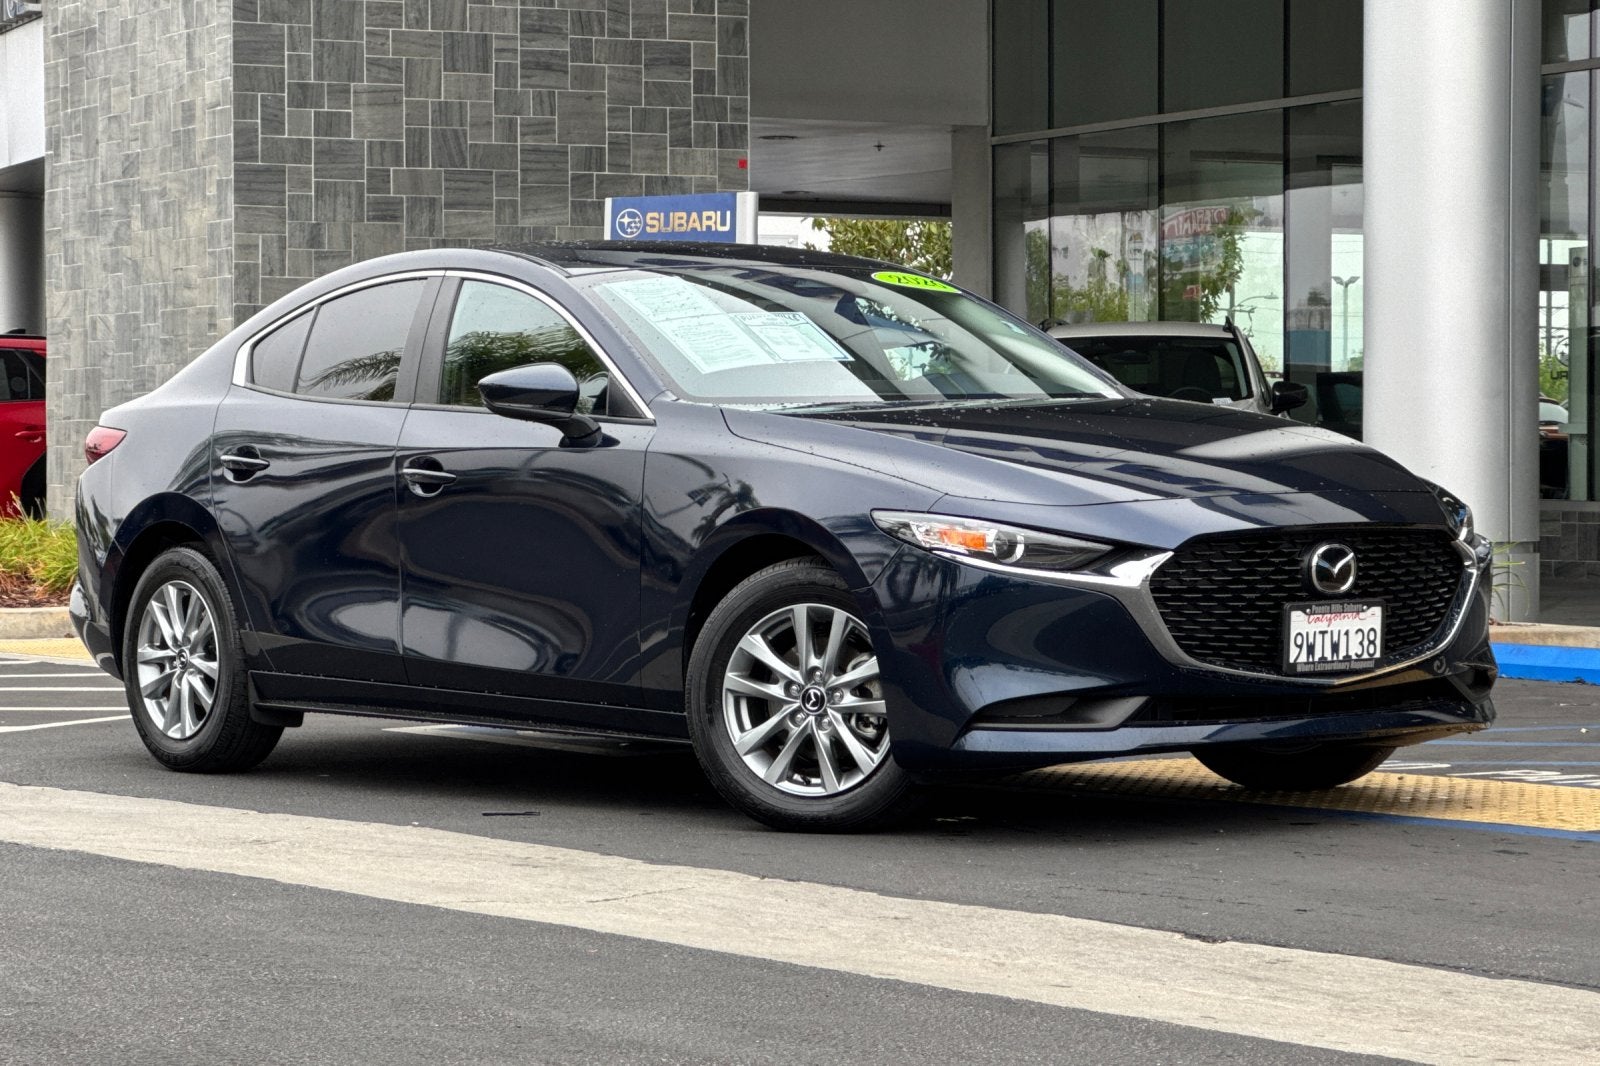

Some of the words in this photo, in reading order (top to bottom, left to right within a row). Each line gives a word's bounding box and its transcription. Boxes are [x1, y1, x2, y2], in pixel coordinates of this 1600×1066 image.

[645, 210, 731, 233] SUBARU
[1307, 612, 1366, 627] California
[1293, 627, 1378, 663] 9WIW138
